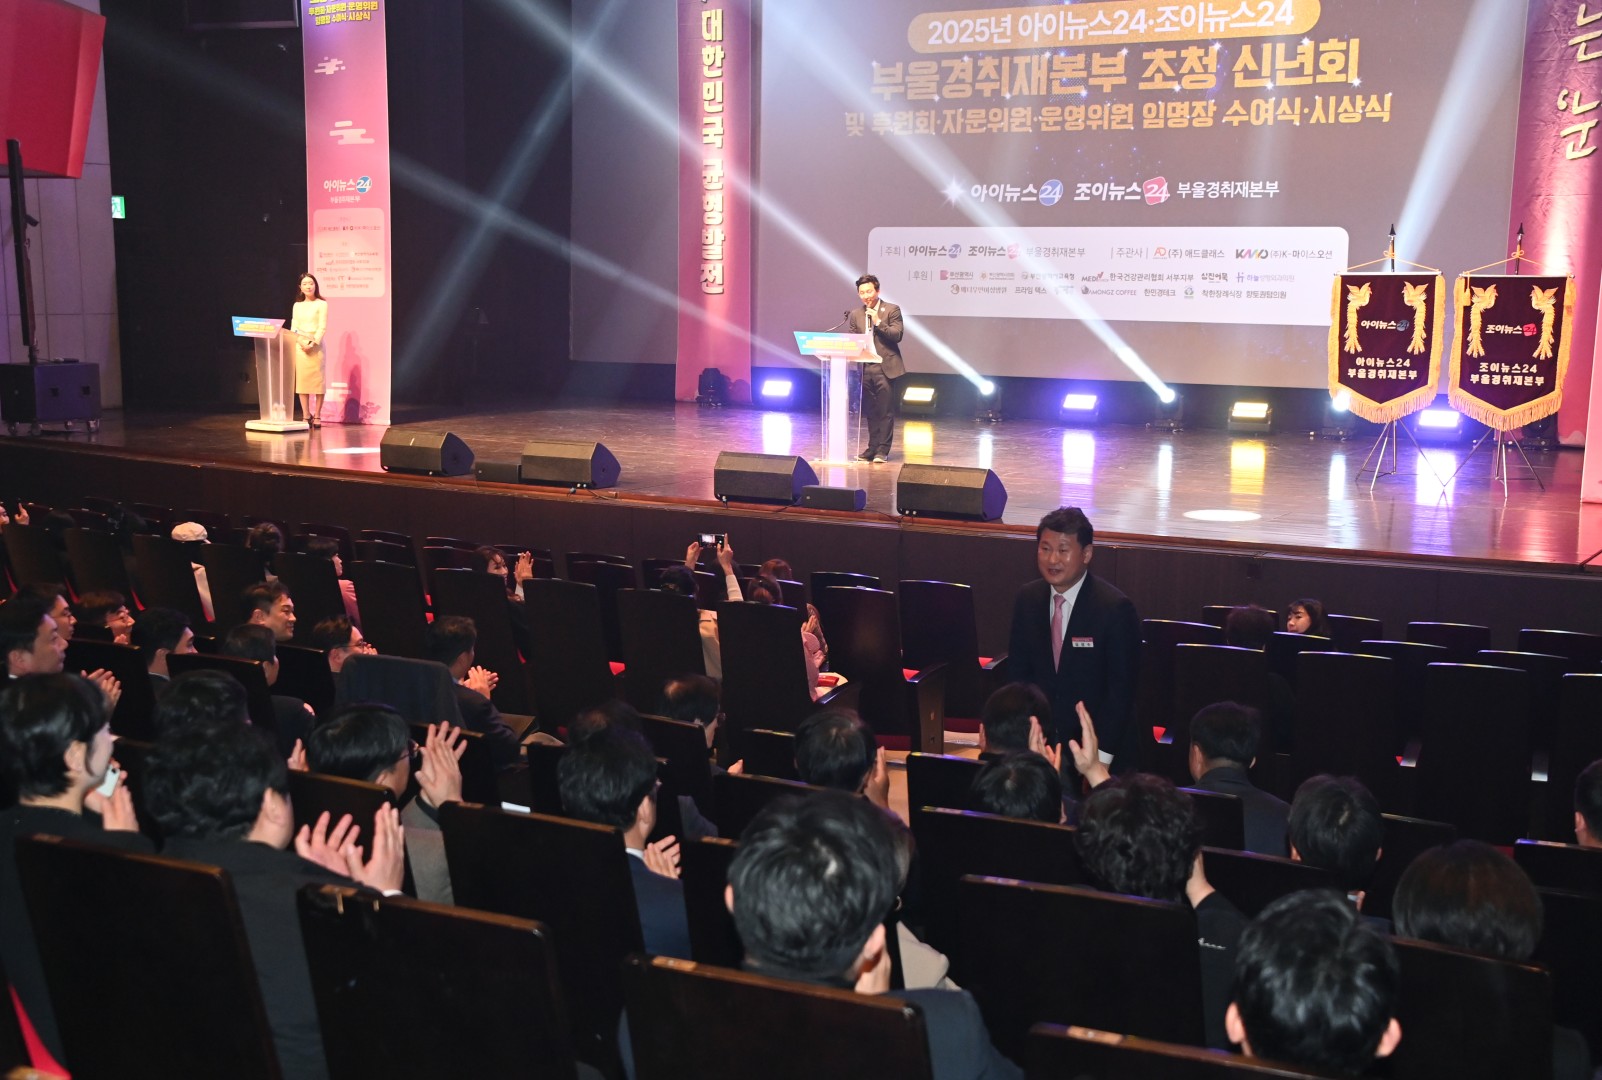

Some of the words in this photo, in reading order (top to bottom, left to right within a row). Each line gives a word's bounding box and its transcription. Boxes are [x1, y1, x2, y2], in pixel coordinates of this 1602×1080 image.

[927, 14, 1012, 45] 2025년
[1018, 0, 1295, 42] 아이뉴스24·조이뉴스24
[871, 53, 1127, 101] 부울경취재본부
[1138, 46, 1218, 90] 초청
[1232, 38, 1360, 88] 신년회
[701, 9, 725, 149] 대한민국
[845, 112, 865, 137] 및
[872, 103, 1134, 136] 후원회·자문위원·운영위원
[1142, 100, 1217, 129] 임명장
[1223, 93, 1392, 127] 수여식·시상식
[323, 177, 371, 193] 아이뉴스24
[971, 181, 1063, 204] 아이뉴스24
[1074, 179, 1170, 204] 조이뉴스24
[1177, 181, 1280, 199] 부울경취재본부
[701, 158, 725, 295] 균형발전
[908, 244, 962, 258] 아이뉴스24
[1026, 247, 1086, 259] 부울경취재본부
[1115, 247, 1143, 259] 주관사
[1168, 248, 1183, 259] (주)
[1184, 248, 1225, 259] 애드클래스
[911, 270, 928, 281] 후원
[1109, 272, 1164, 282] 한국건강관리협회
[1166, 273, 1194, 282] 서부지부
[1015, 287, 1033, 295] 프라임
[1361, 320, 1409, 331] 아이뉴스24
[1485, 323, 1538, 336] 조이뉴스24
[1355, 357, 1411, 368] 아이뉴스24
[1479, 362, 1538, 374] 조이뉴스24
[1347, 367, 1418, 380] 부울경취재본부
[1470, 373, 1545, 387] 부울경취재본부
